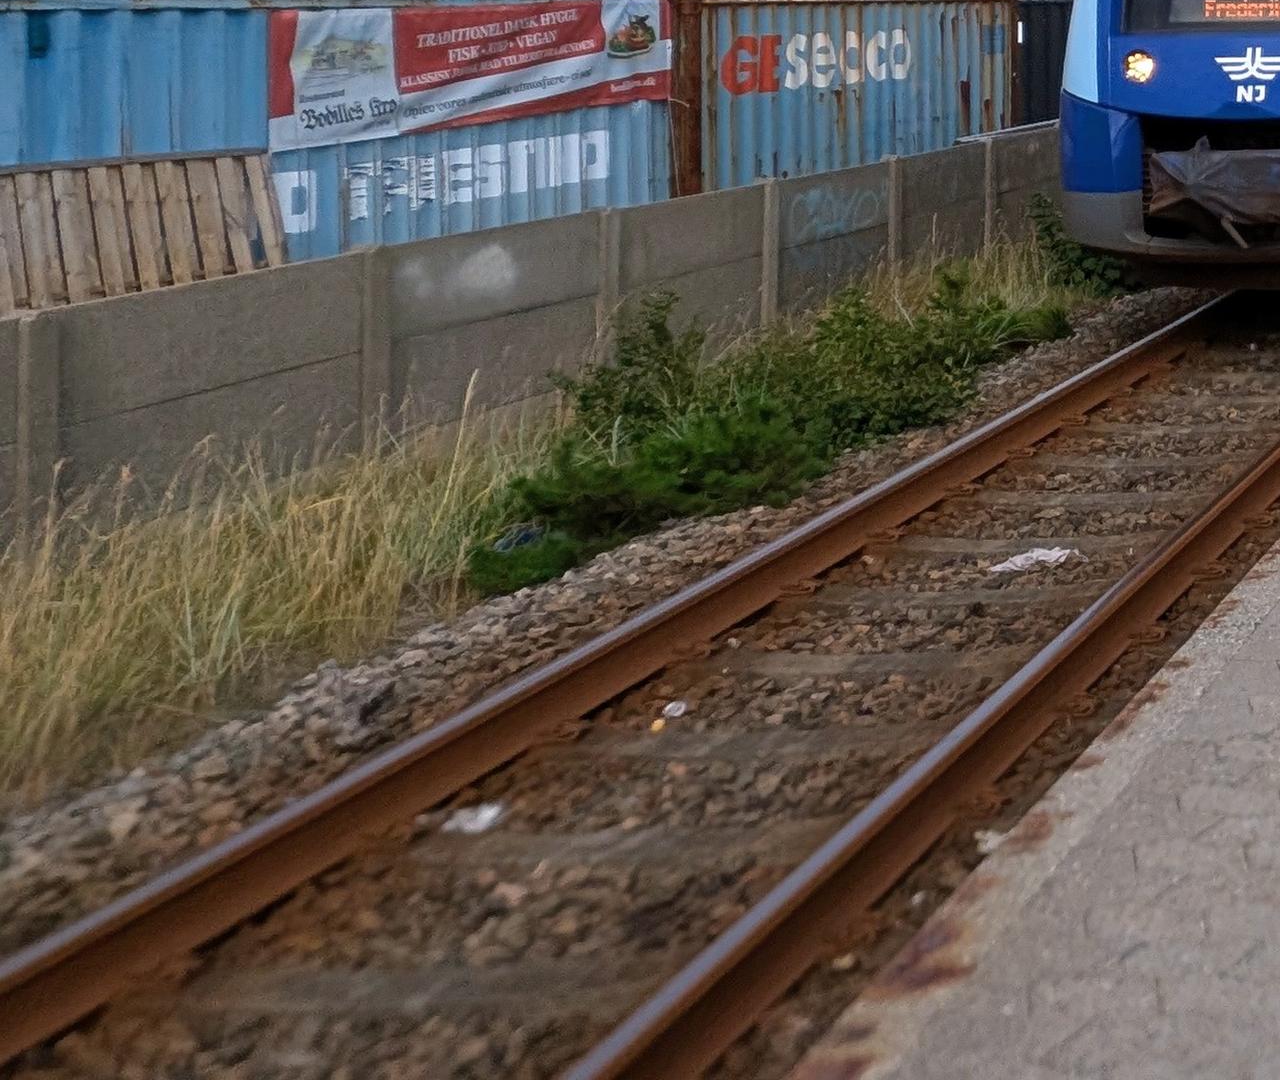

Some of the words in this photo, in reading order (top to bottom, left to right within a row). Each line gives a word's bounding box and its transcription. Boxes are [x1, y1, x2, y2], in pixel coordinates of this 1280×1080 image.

[448, 44, 480, 63] FISK
[516, 30, 558, 49] VEGAN
[1236, 85, 1266, 102] NJ
